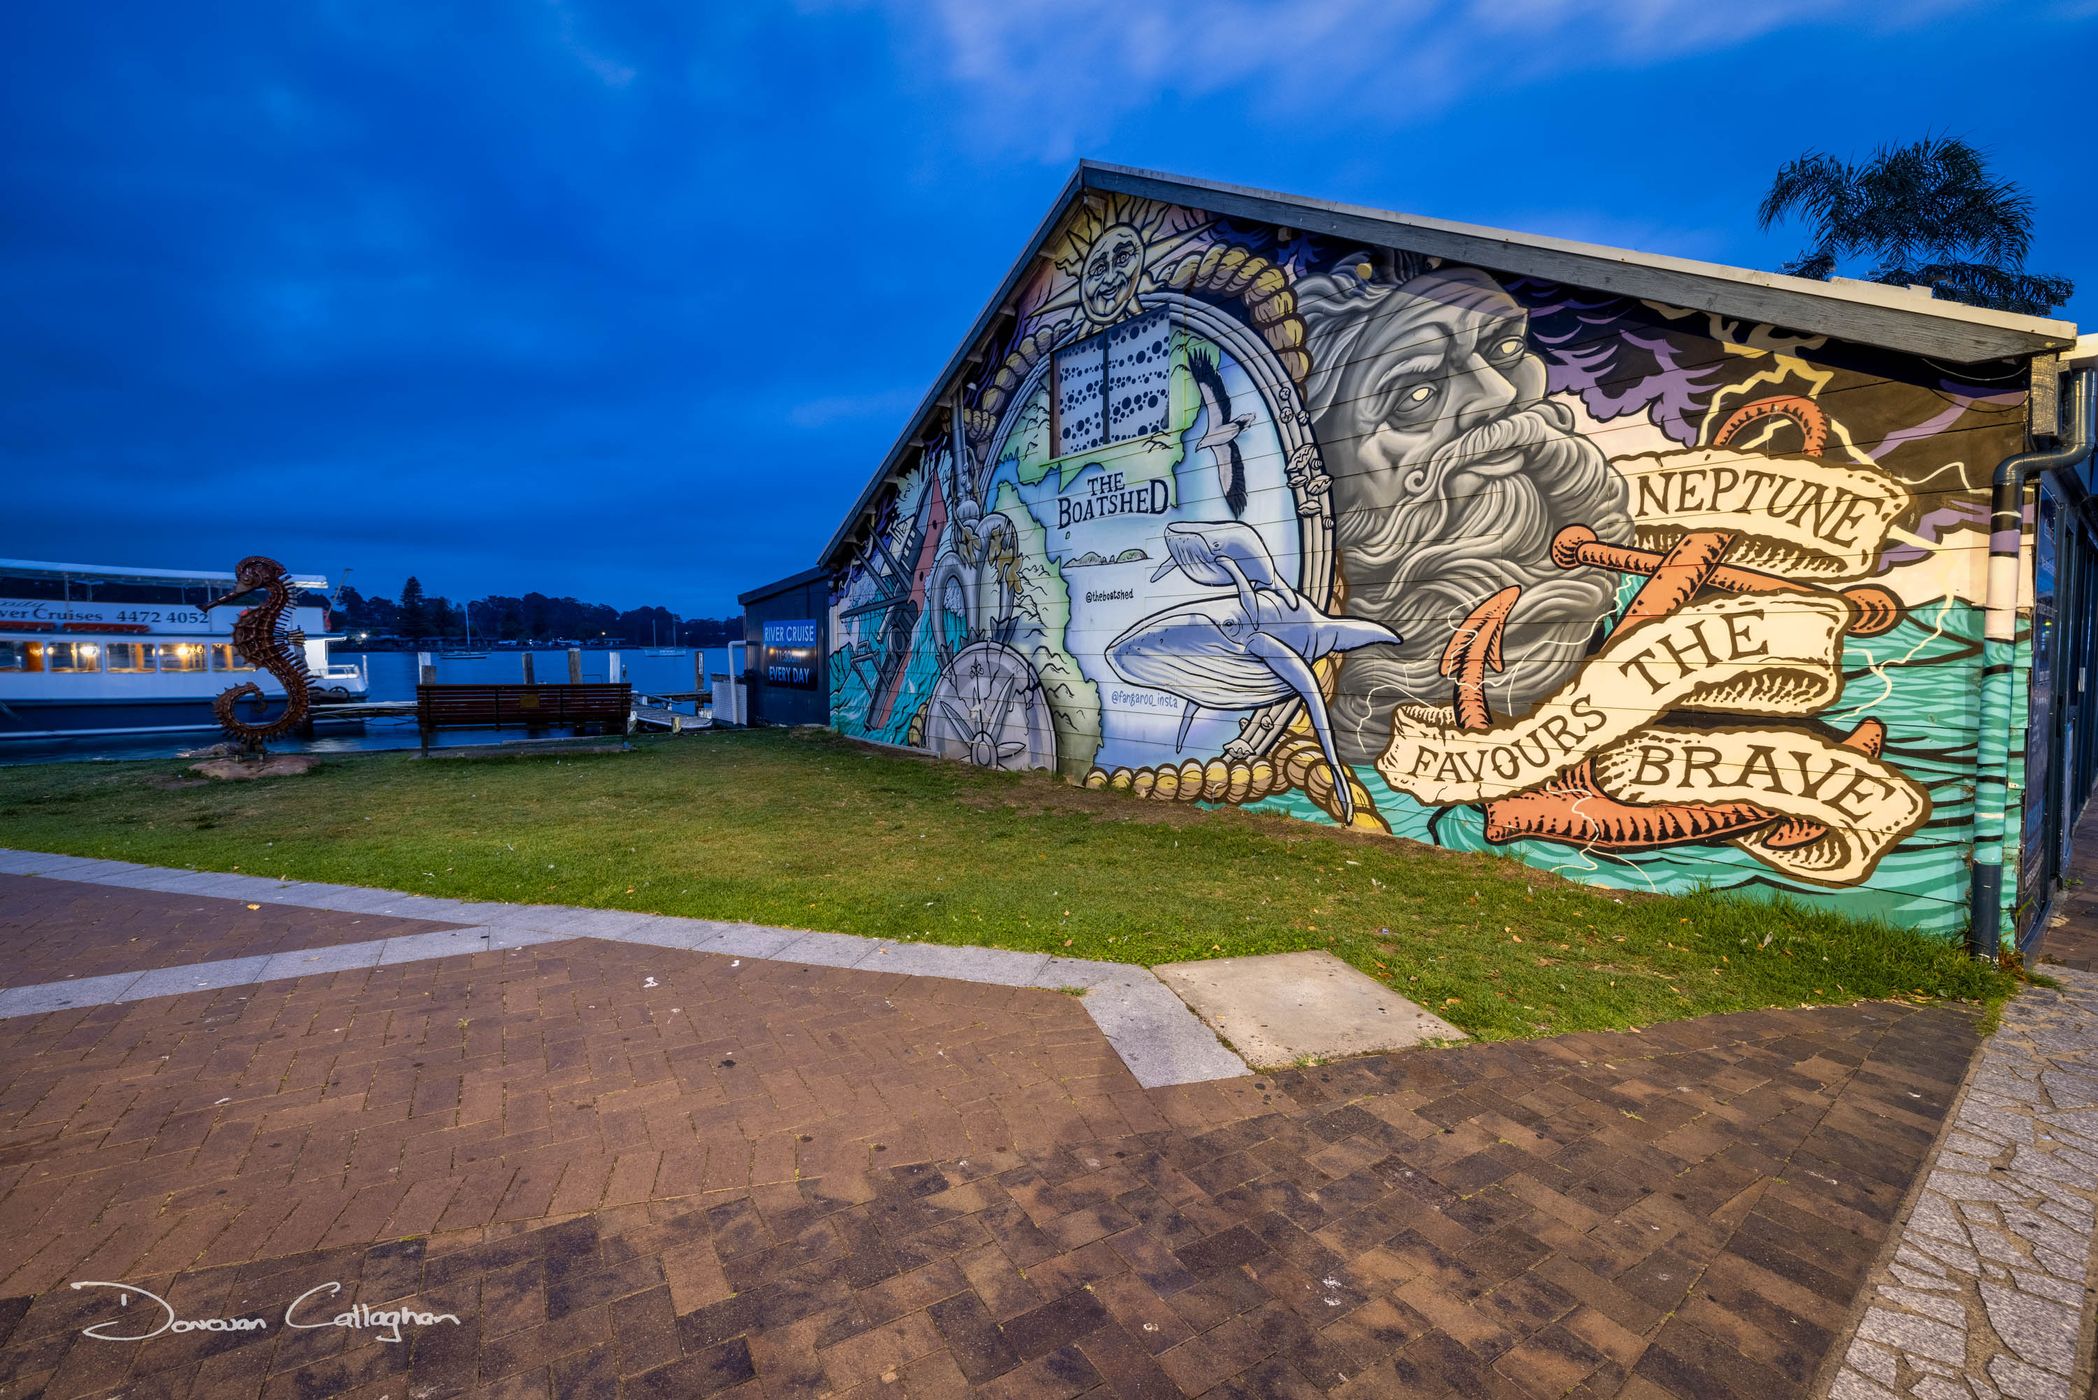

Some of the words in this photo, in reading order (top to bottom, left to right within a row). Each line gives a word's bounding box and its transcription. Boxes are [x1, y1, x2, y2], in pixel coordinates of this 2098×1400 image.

[1087, 472, 1126, 497] THE
[1057, 479, 1170, 530] BOATSHED
[1635, 469, 1884, 547] NEPTUNE
[1085, 588, 1134, 603] @theboatshed
[33, 607, 103, 621] Cruises
[116, 611, 161, 622] 4472
[166, 612, 209, 624] 4052
[764, 626, 785, 642] RIVER
[786, 625, 815, 642] CRUISE
[1619, 608, 1770, 697] THE
[768, 666, 791, 683] EVERY
[792, 667, 810, 685] DAY
[1111, 690, 1179, 709] @fangaroo_insta
[1407, 695, 1608, 784] FAVOURS
[1633, 743, 1896, 826] BRAVE
